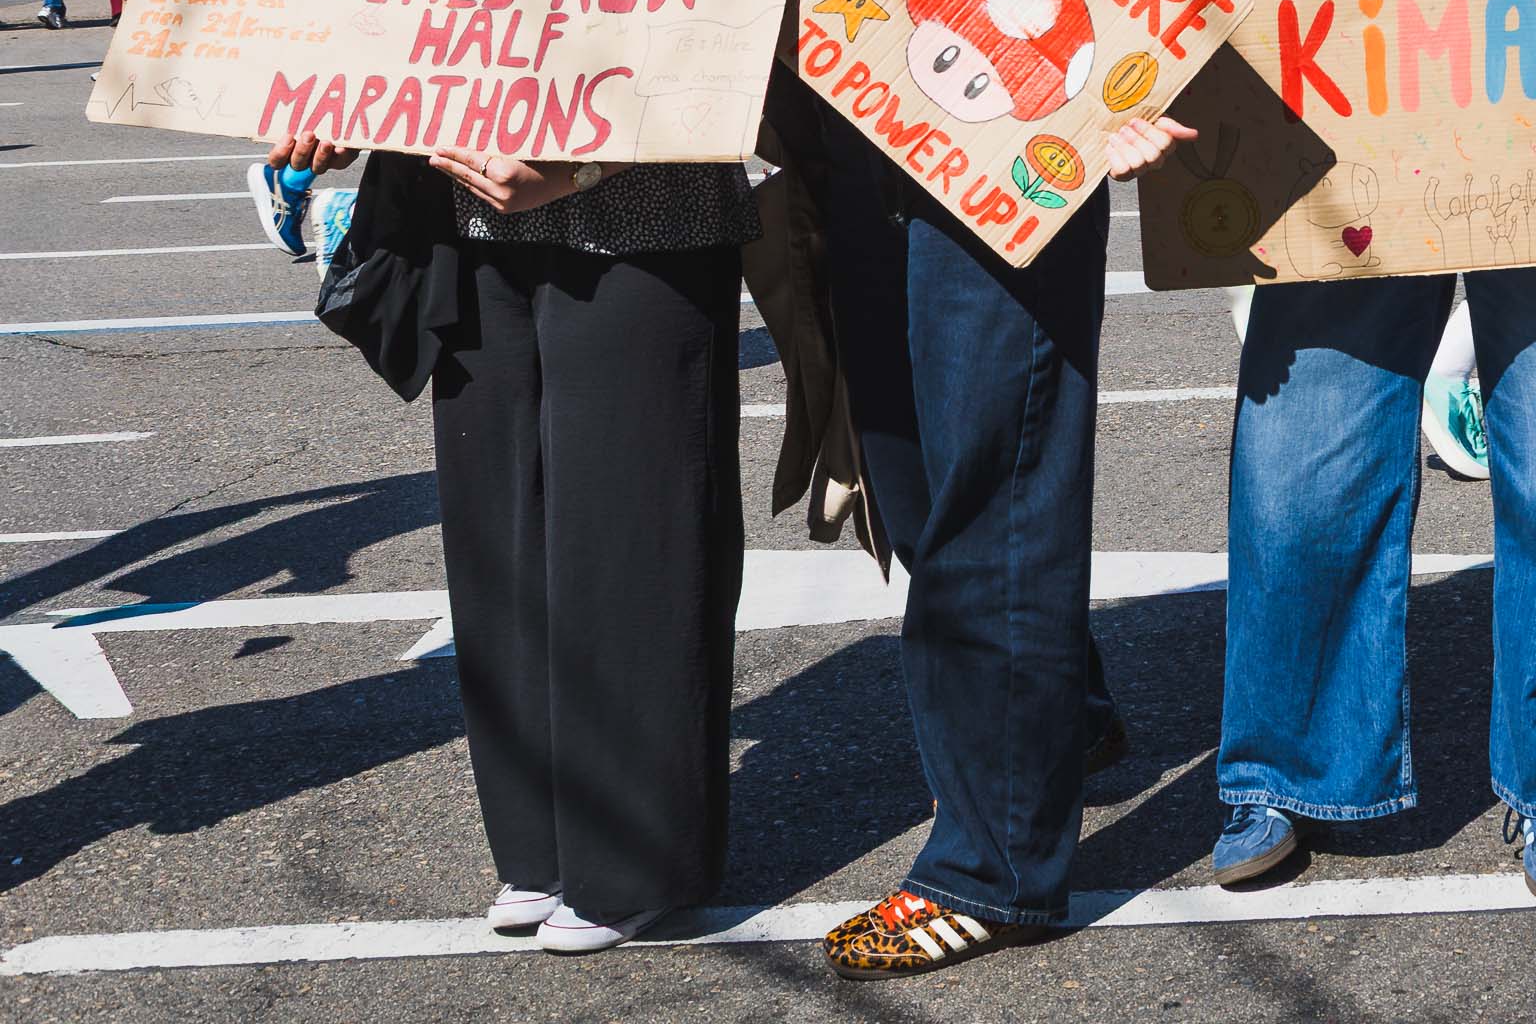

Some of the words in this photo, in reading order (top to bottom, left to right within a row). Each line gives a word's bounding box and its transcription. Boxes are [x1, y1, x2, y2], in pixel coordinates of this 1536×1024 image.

[409, 9, 570, 73] HALF
[258, 67, 635, 157] MARATHONS
[797, 18, 842, 78] TO
[831, 60, 969, 196] POWER
[959, 174, 1040, 252] UP!
